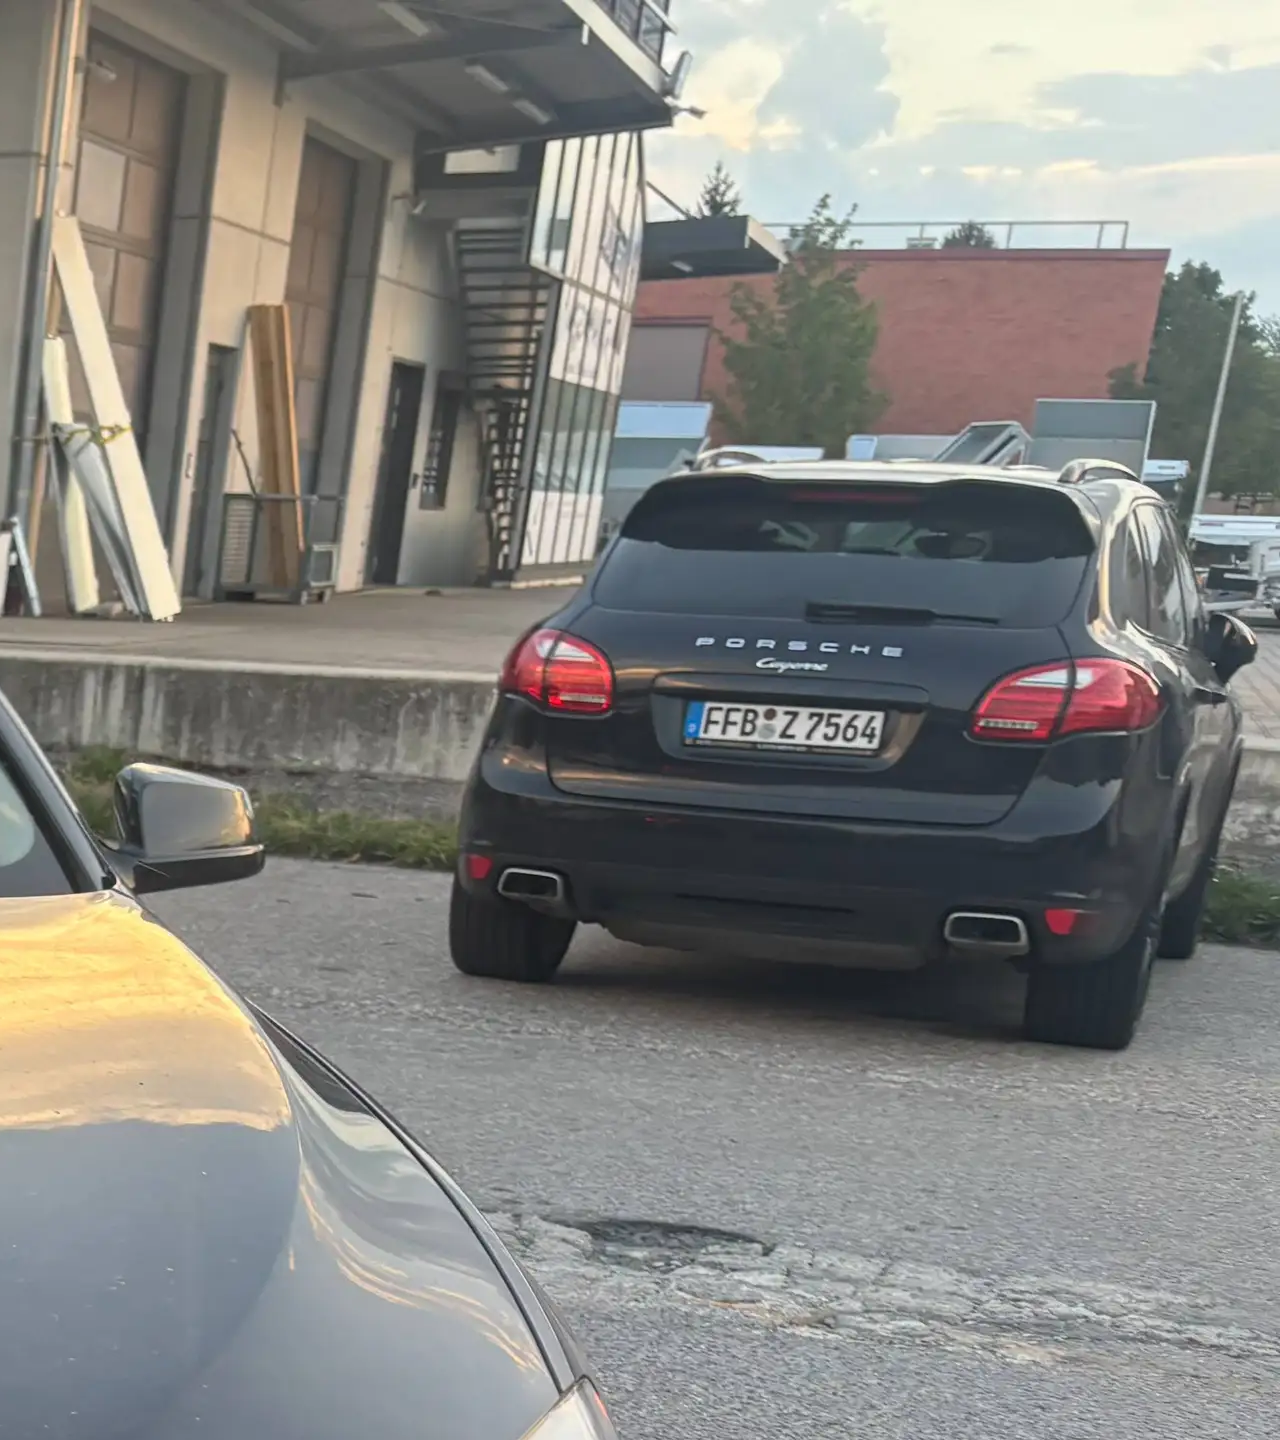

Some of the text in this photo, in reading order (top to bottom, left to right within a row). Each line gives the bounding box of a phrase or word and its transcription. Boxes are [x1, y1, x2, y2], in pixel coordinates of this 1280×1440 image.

[695, 636, 904, 657] PORSCHE
[755, 657, 829, 673] Cayenne
[702, 706, 877, 745] FFB Z 7564
